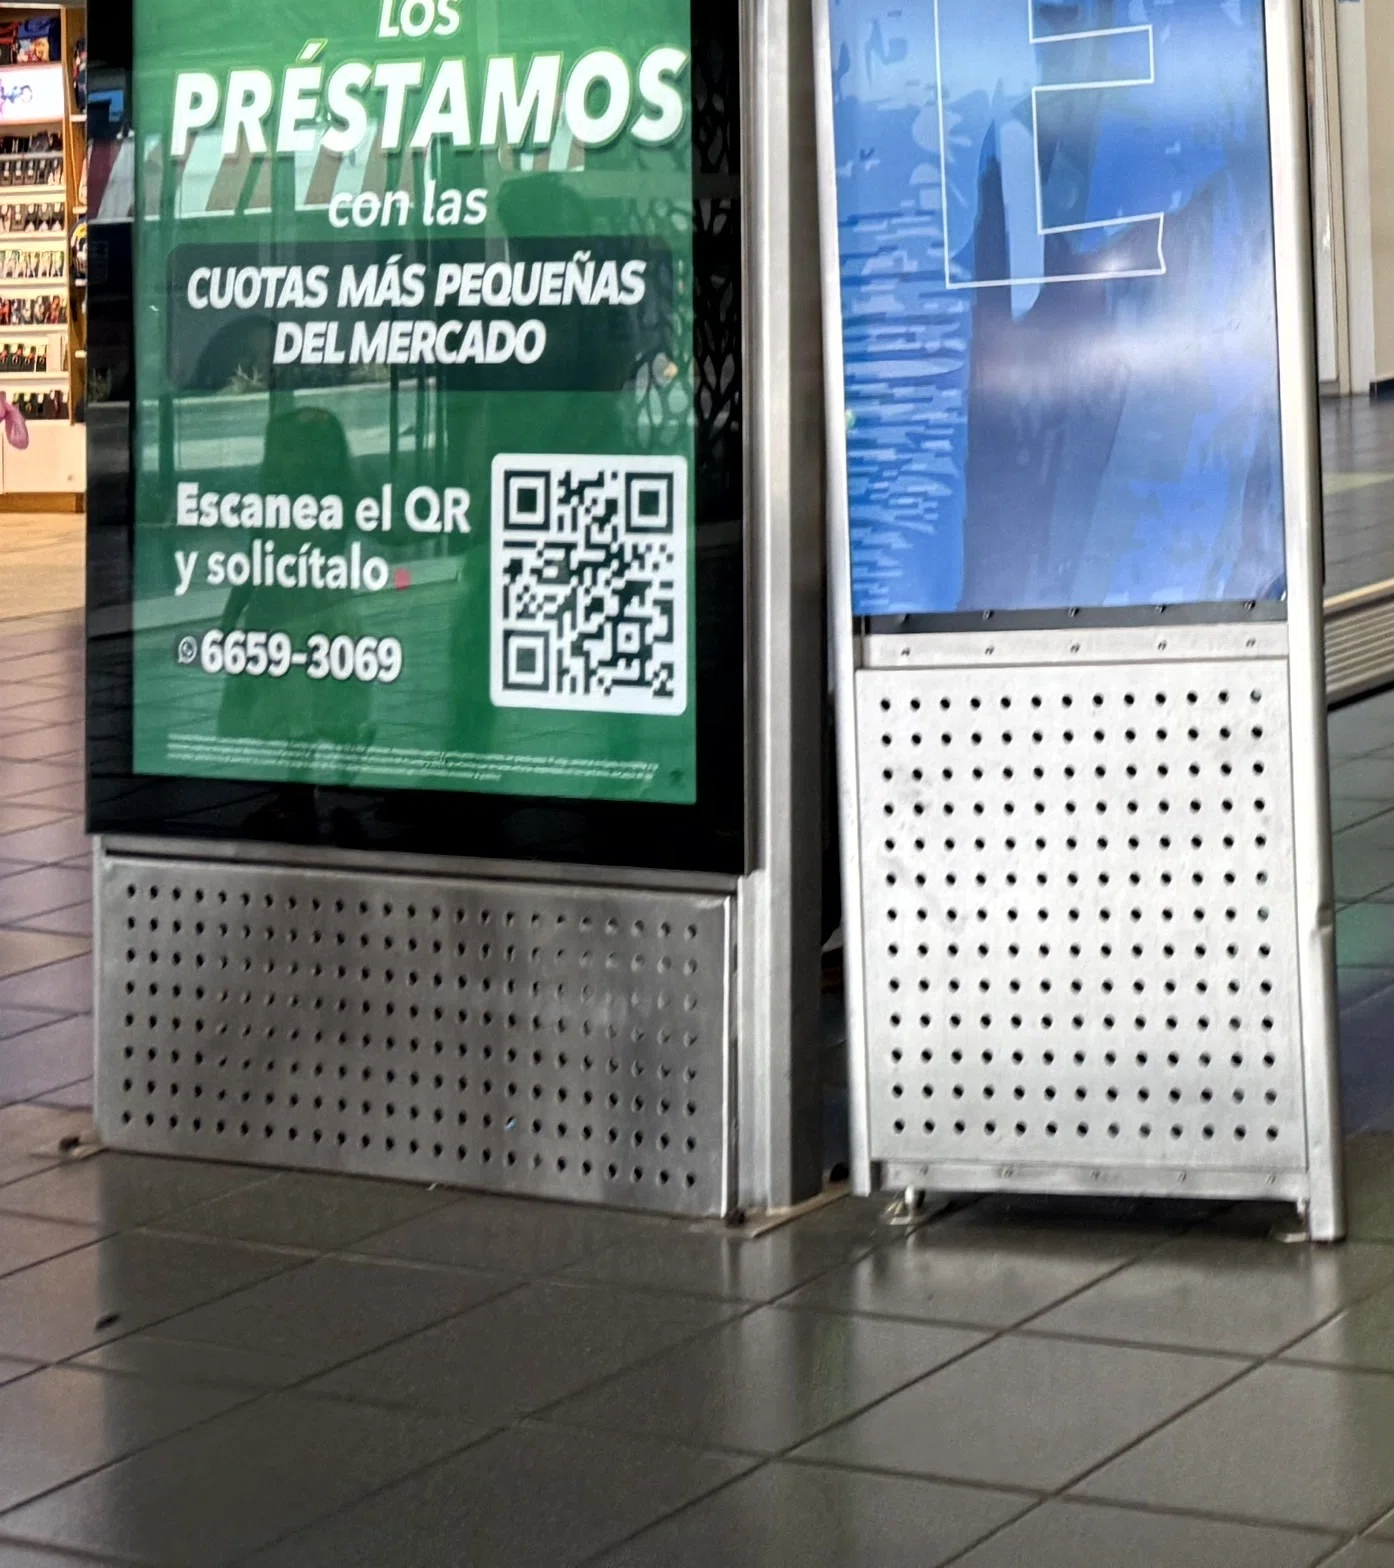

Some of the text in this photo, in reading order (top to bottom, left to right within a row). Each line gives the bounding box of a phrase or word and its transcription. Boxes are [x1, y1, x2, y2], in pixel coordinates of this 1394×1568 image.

[169, 38, 690, 158] PRÉSTAMOS
[328, 180, 488, 230] con las
[187, 250, 647, 310] CUOTAS MÁS PEQUEÑAS
[273, 320, 547, 365] DEL MERCADO
[176, 481, 472, 534] Escanea el QR
[174, 550, 199, 597] y
[201, 628, 403, 683] 6659-3069
